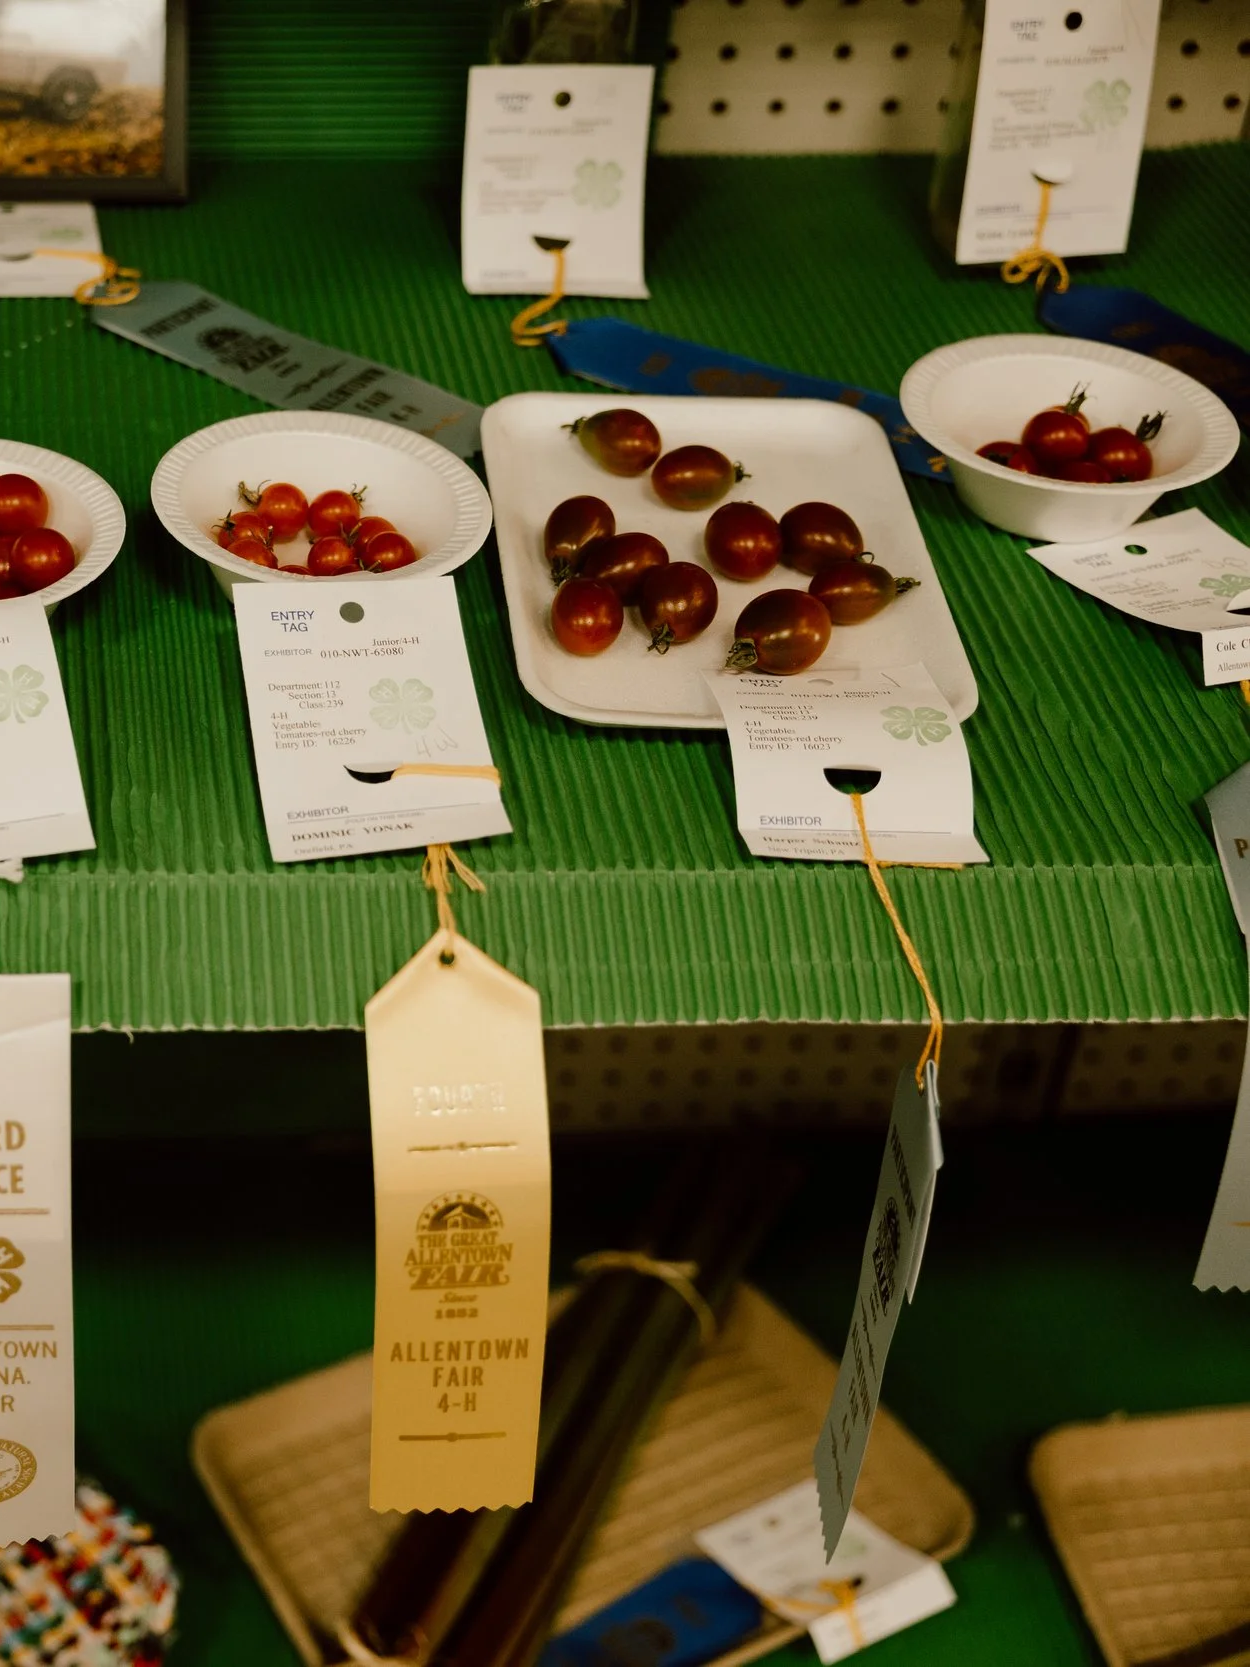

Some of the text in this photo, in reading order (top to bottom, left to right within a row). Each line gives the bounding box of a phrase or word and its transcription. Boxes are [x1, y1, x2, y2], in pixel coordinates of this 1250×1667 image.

[271, 610, 315, 621] ENTRY
[282, 622, 308, 632] TAG
[372, 636, 420, 647] Junior/4-H
[1216, 641, 1236, 652] Cole
[264, 647, 404, 659] EXHIBITOR 010-NWT-65080
[270, 712, 288, 720] 4-H
[272, 720, 321, 731] Vegetables
[745, 727, 796, 735] Vegetables
[273, 727, 367, 740] Tomatoes-red cherry
[813, 735, 843, 744] cherry
[275, 737, 356, 750] Entry ID: 16226
[749, 742, 773, 751] Entry
[287, 805, 350, 821] EXHIBITOR
[759, 816, 822, 826] EXHIBITOR
[291, 822, 414, 841] DOMINIC YONAK
[417, 1231, 498, 1248] THE GREAT
[404, 1243, 514, 1267] ALLENTOWN
[408, 1263, 510, 1288] FAIR
[439, 1292, 478, 1304] Since
[390, 1338, 530, 1363] ALLENTOWN
[432, 1366, 484, 1387] FAIR
[437, 1392, 477, 1413] 4-H
